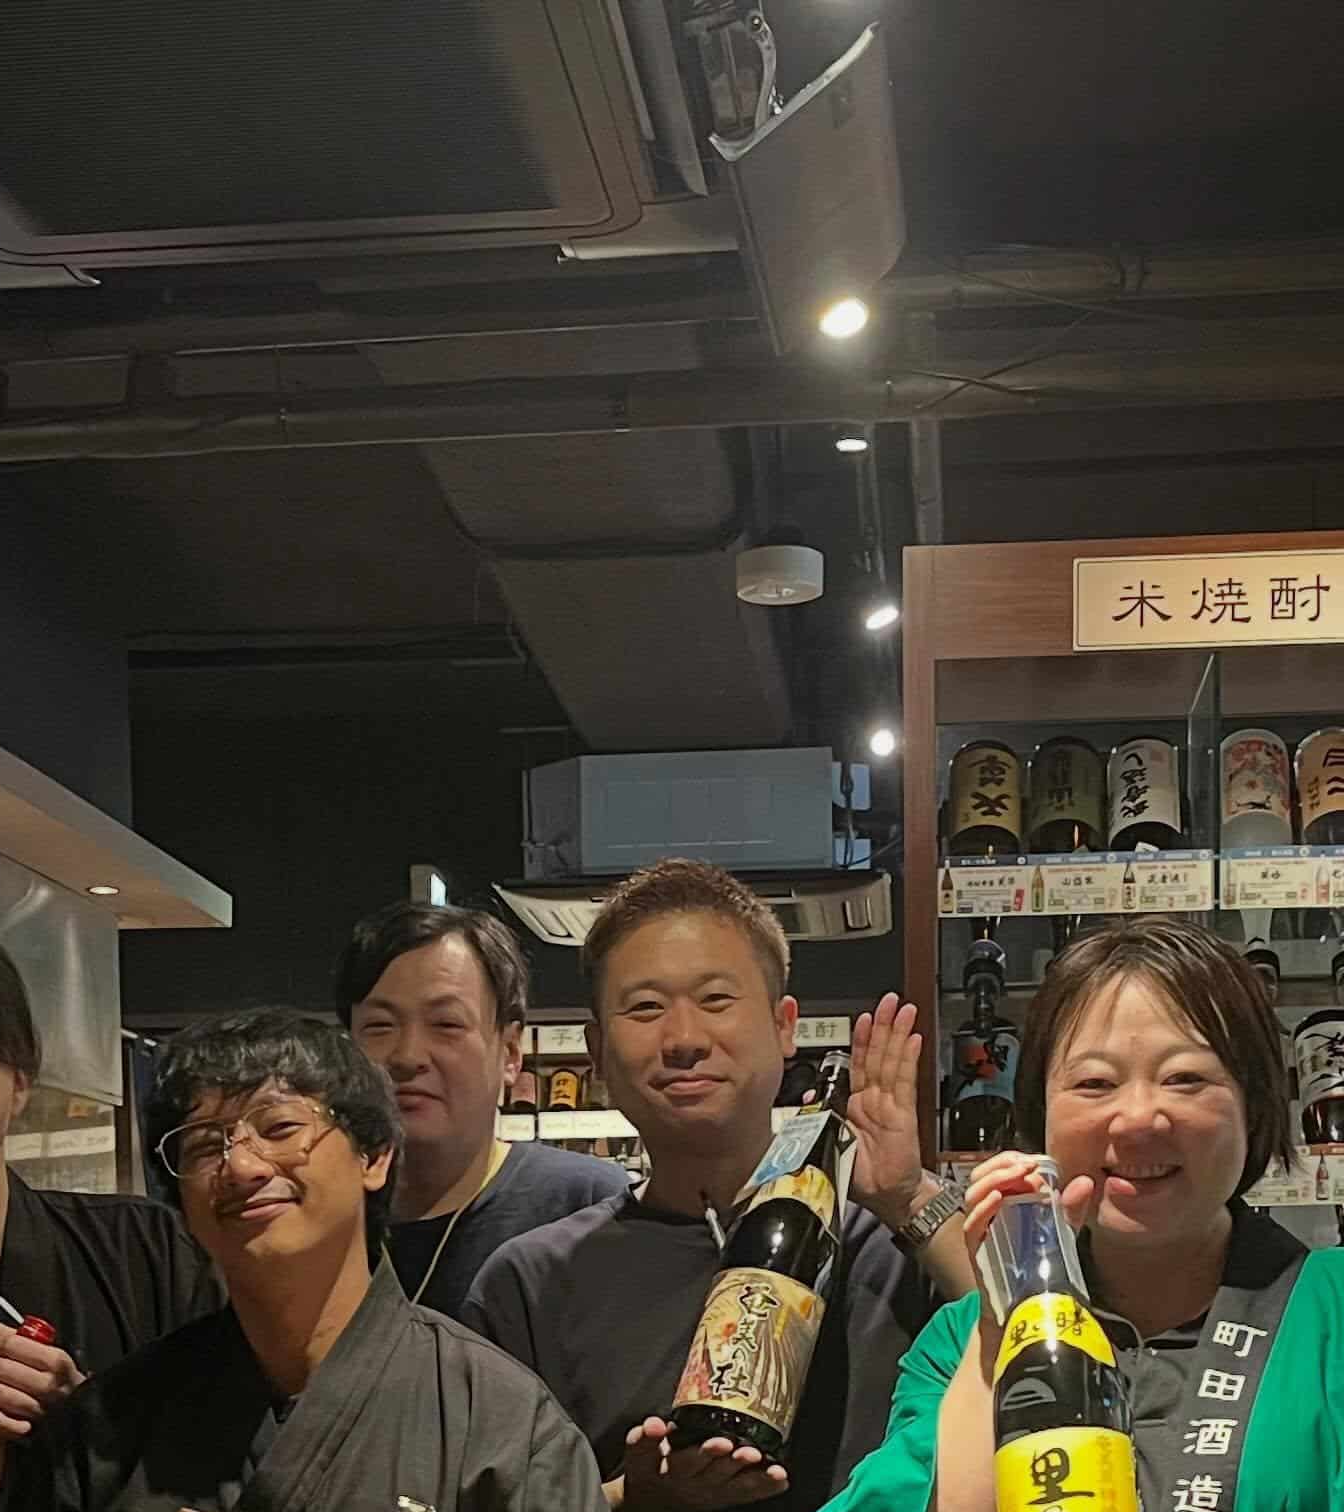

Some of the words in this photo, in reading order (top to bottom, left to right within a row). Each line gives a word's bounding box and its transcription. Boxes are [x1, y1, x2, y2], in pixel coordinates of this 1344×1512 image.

[1112, 574, 1331, 628] 米焼酎
[711, 1284, 778, 1398] 奄美の杜
